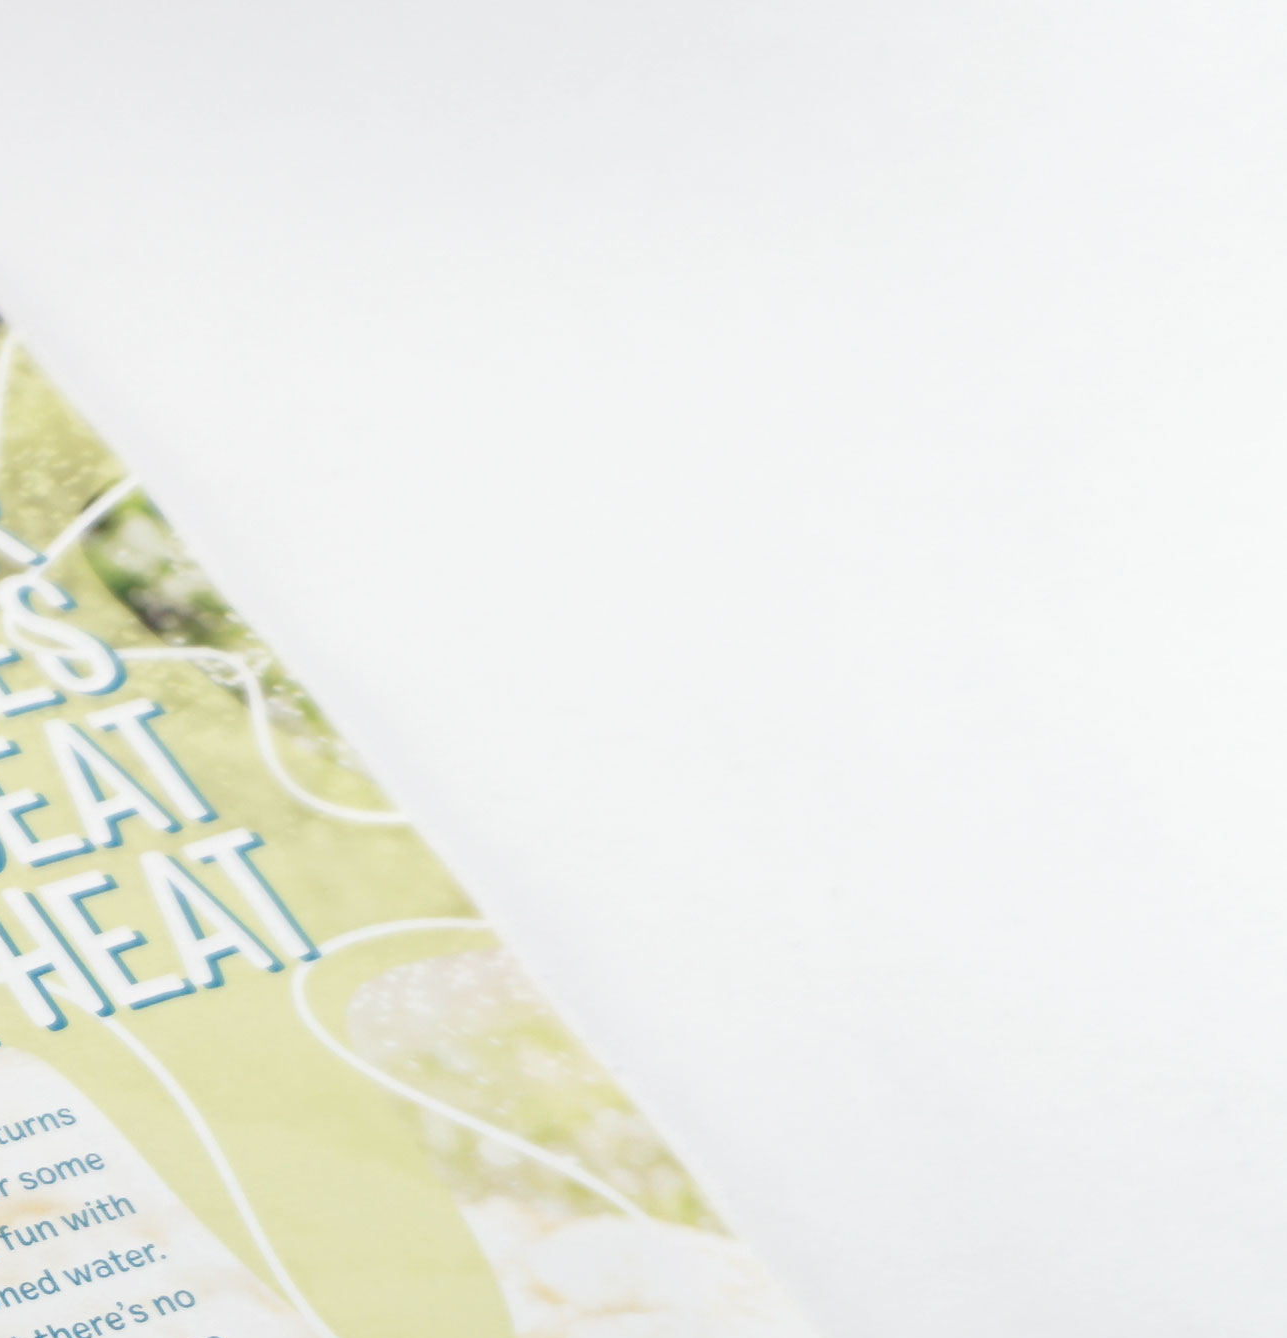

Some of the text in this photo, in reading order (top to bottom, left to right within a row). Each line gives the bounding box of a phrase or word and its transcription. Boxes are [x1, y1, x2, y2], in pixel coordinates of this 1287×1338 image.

[19, 1152, 106, 1191] some
[0, 1221, 54, 1250] fun
[61, 1191, 136, 1232] with
[62, 1240, 167, 1287] water.
[154, 1292, 196, 1314] no
